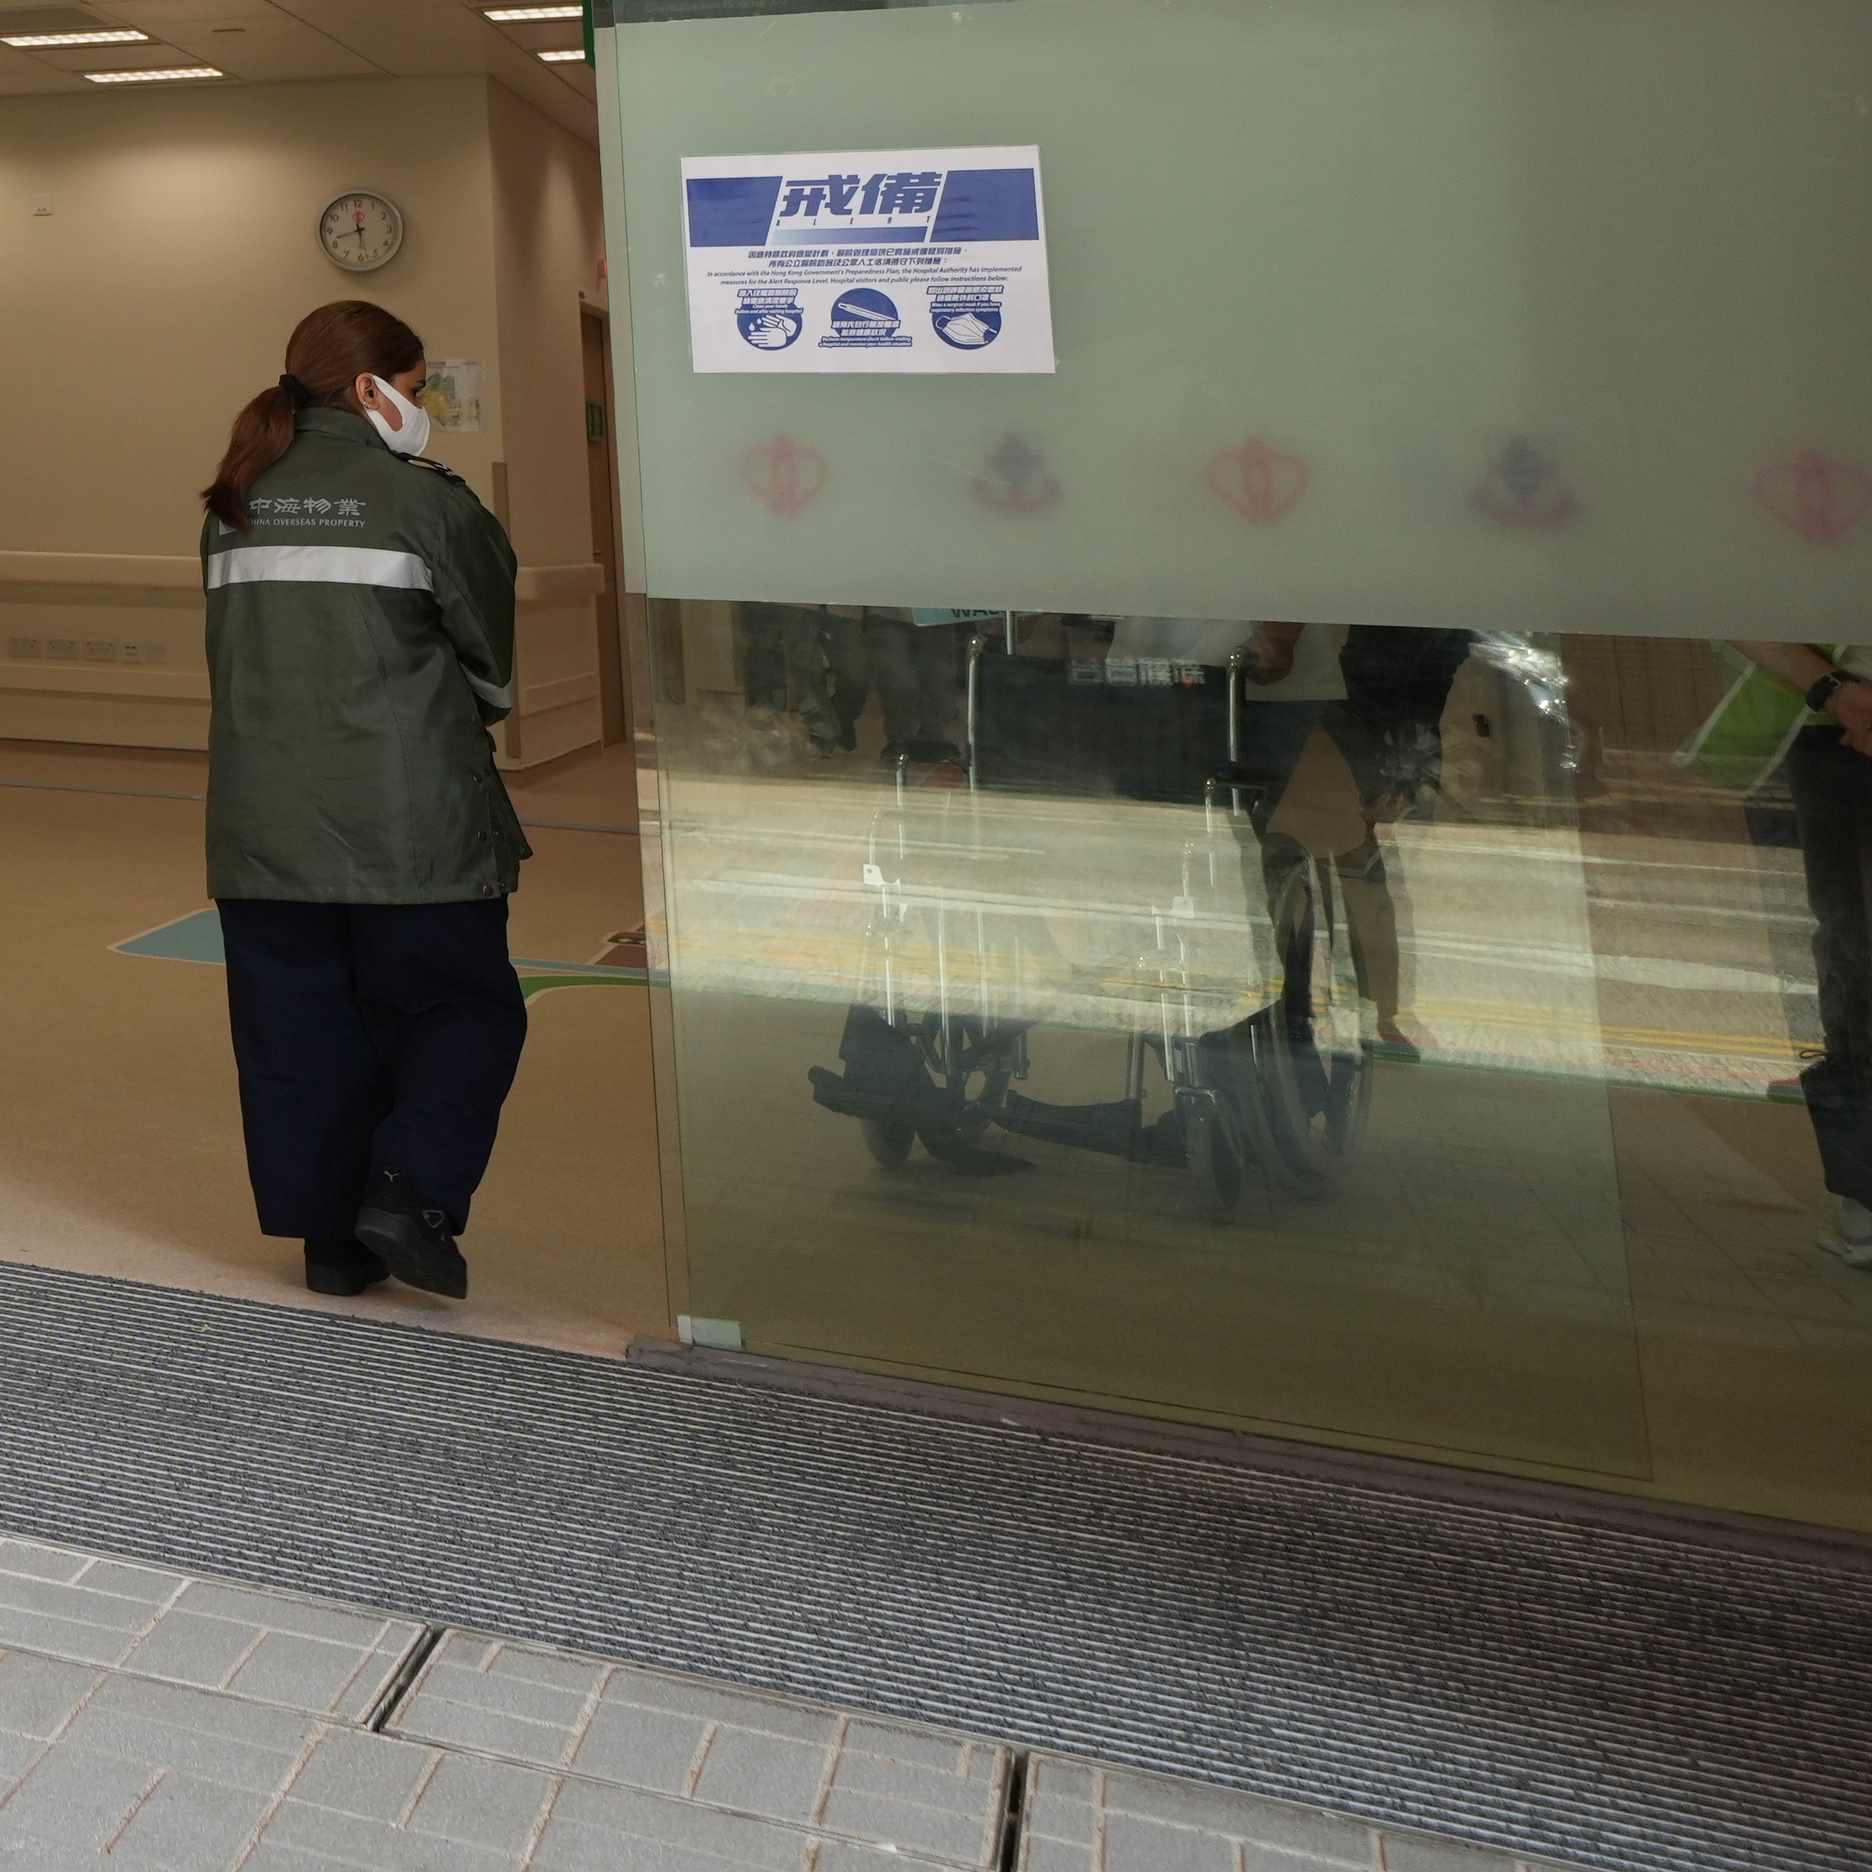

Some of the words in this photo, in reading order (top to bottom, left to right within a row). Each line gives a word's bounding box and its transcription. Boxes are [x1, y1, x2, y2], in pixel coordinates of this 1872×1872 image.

[779, 171, 943, 217] 戒備
[249, 496, 367, 517] 中海物業
[273, 518, 316, 527] OVERSEAS
[319, 518, 366, 528] PROPERTY
